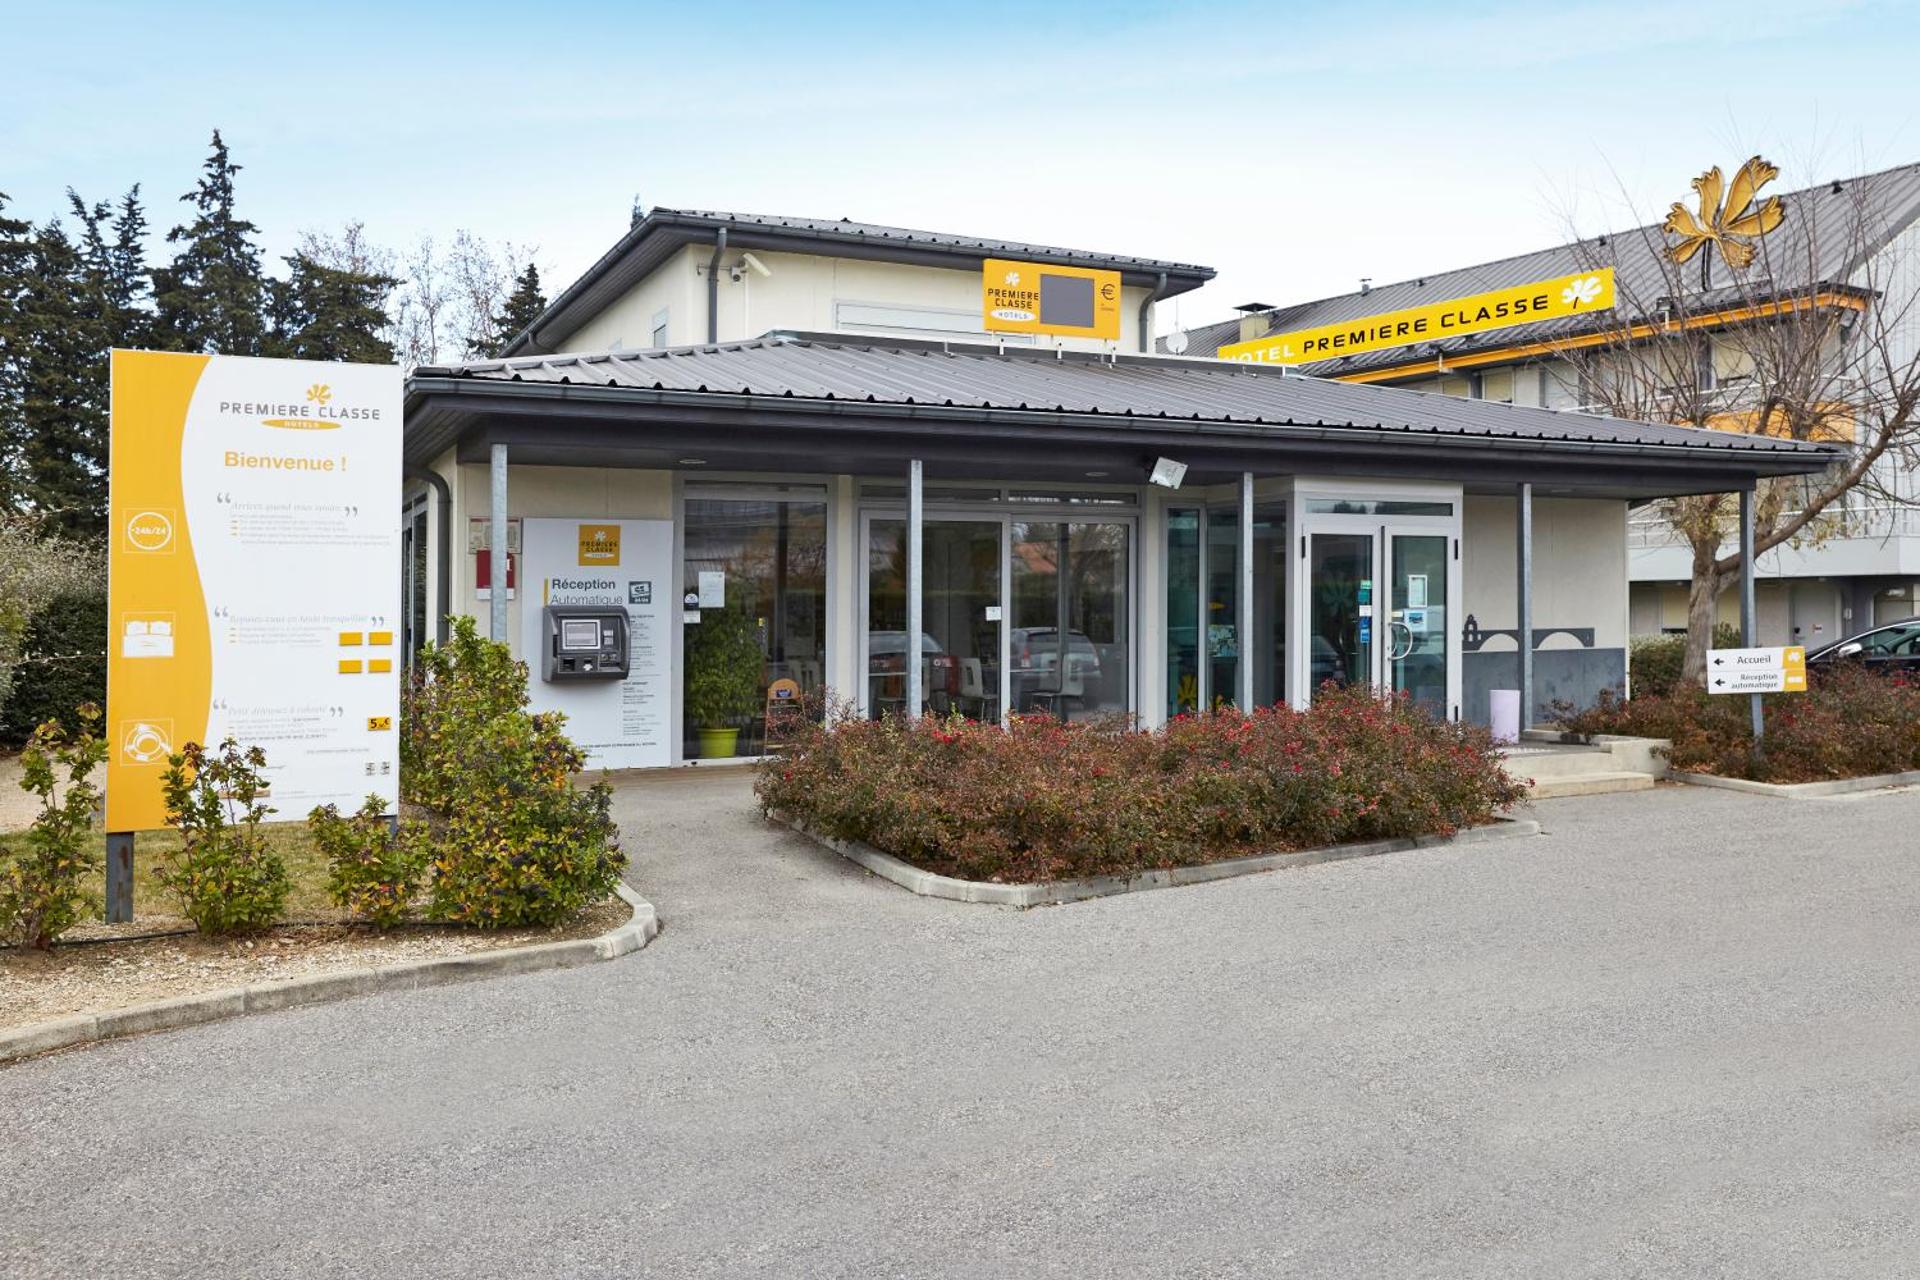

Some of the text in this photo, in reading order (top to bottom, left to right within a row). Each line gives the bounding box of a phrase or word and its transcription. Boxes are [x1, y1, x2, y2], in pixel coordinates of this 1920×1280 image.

[988, 287, 1039, 301] PREMIERE
[995, 298, 1032, 310] CLASSE
[998, 310, 1029, 320] HOTELS
[1222, 294, 1550, 364] OTEL PREMIERE CLASSE
[219, 402, 381, 421] PREMIERE CLASSE
[223, 451, 336, 472] Bienvenue
[552, 577, 616, 591] Réception
[551, 593, 623, 605] Automatique
[1736, 654, 1771, 665] Accueil
[1740, 672, 1778, 682] Réception
[1731, 681, 1778, 690] automatique
